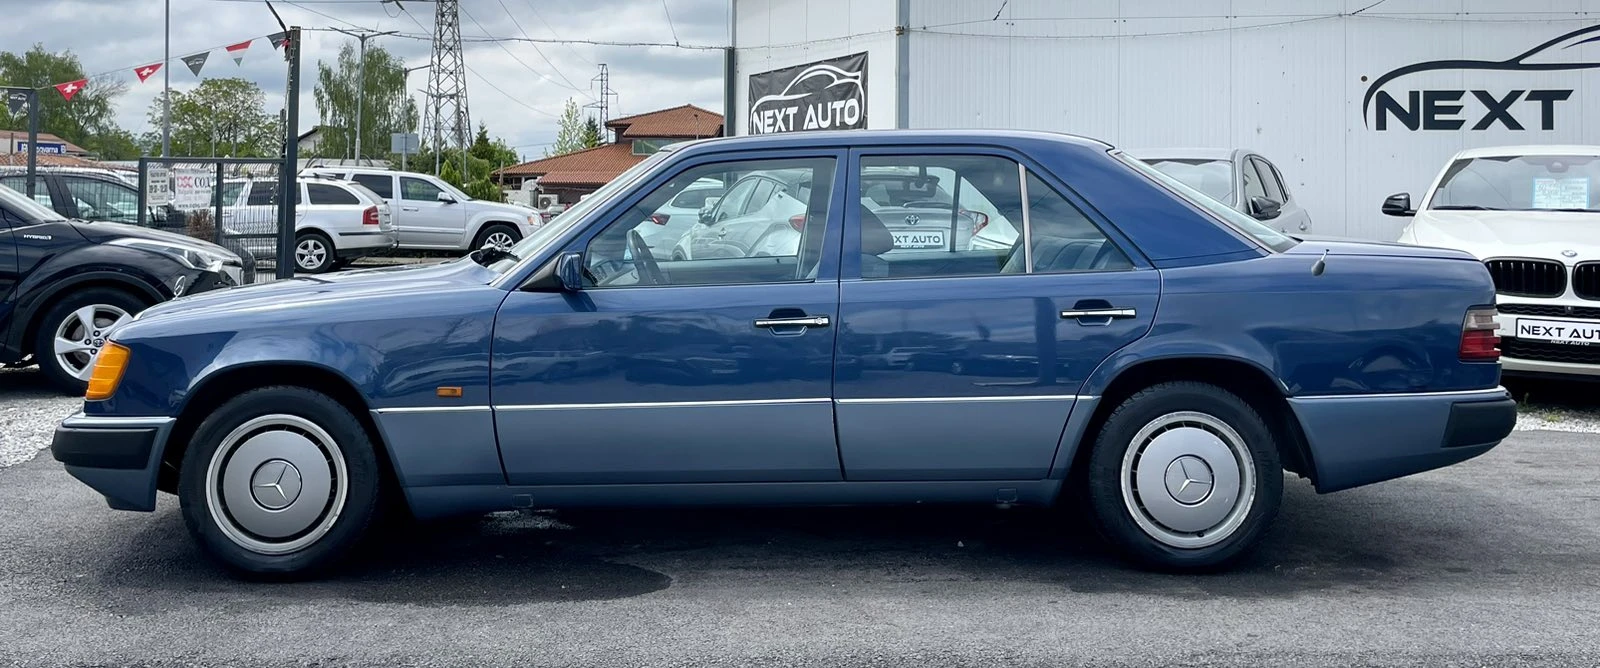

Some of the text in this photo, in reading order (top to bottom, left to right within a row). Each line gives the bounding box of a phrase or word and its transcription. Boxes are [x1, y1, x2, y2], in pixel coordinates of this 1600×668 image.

[752, 98, 860, 135] NEXT AUTO
[1375, 89, 1574, 131] NEXT
[911, 235, 941, 244] AUTO
[1520, 325, 1565, 337] NEXT
